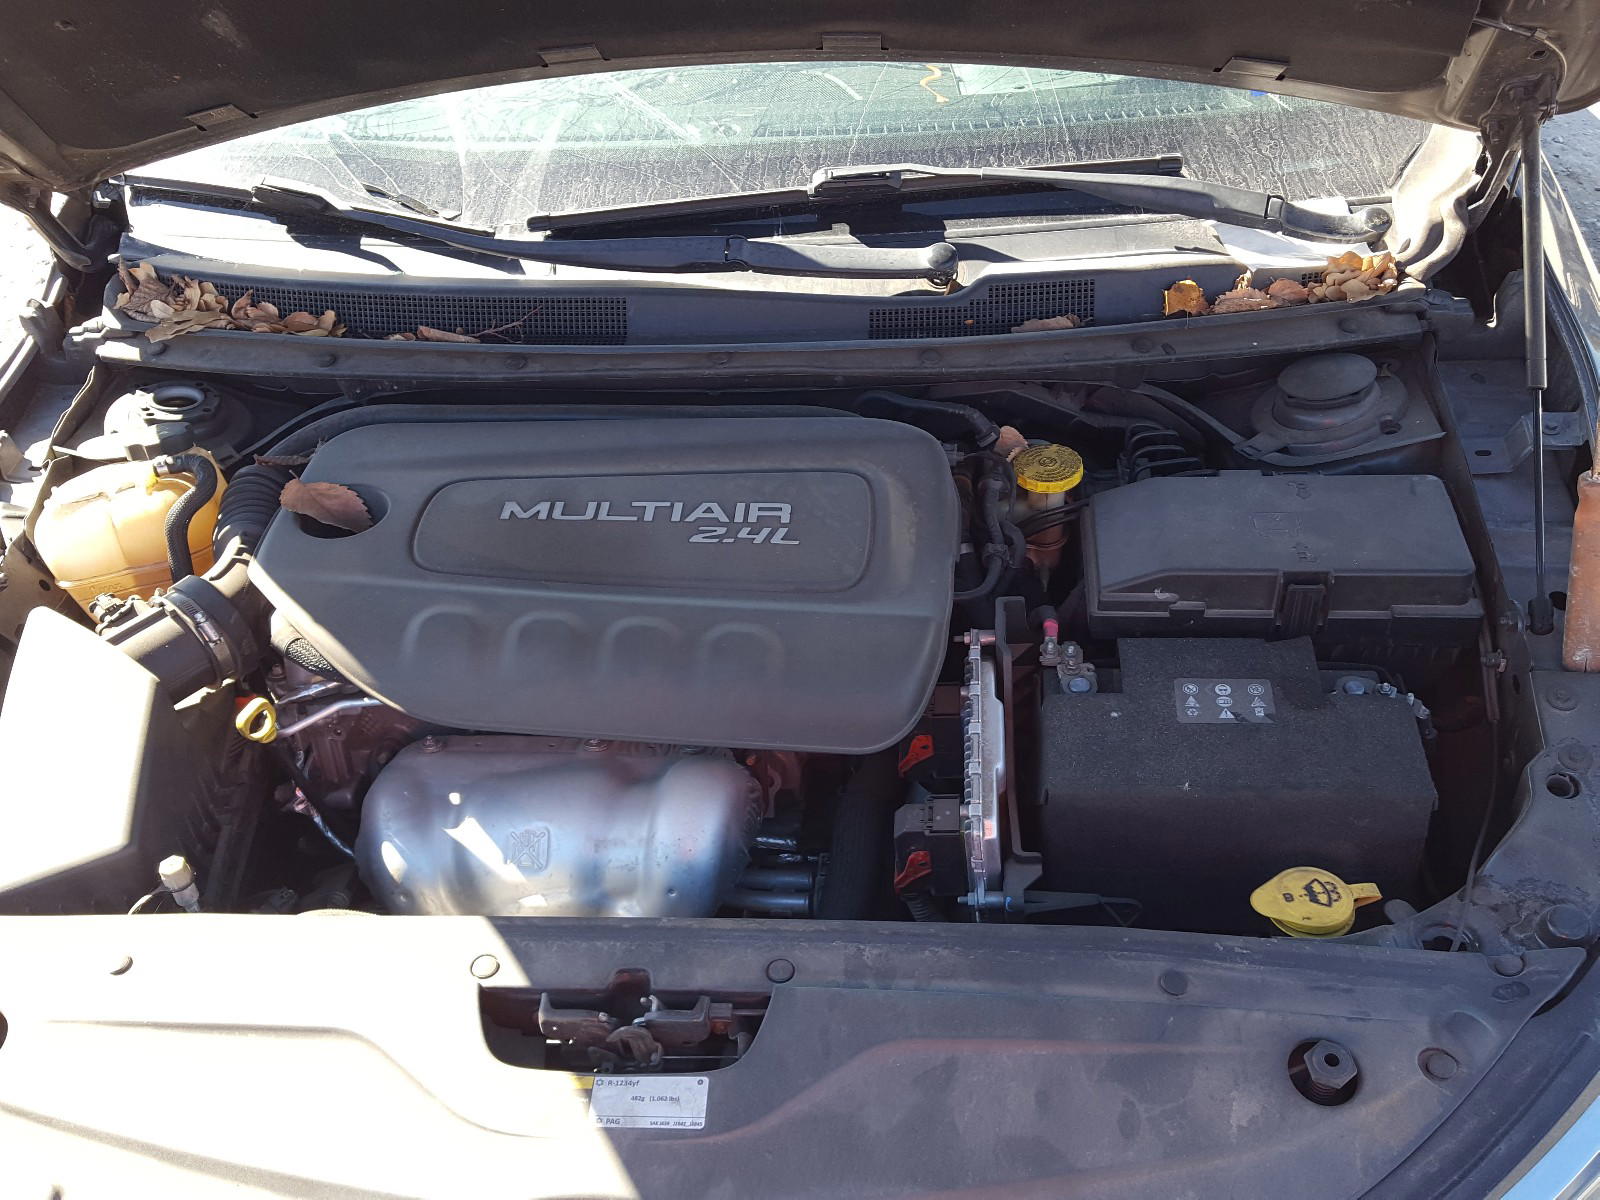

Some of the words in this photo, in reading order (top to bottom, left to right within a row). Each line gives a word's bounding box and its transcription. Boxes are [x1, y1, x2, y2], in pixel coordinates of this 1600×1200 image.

[499, 501, 792, 523] MULTIAIR
[688, 526, 800, 545] 2.4L
[607, 1079, 640, 1087] R-1234yf
